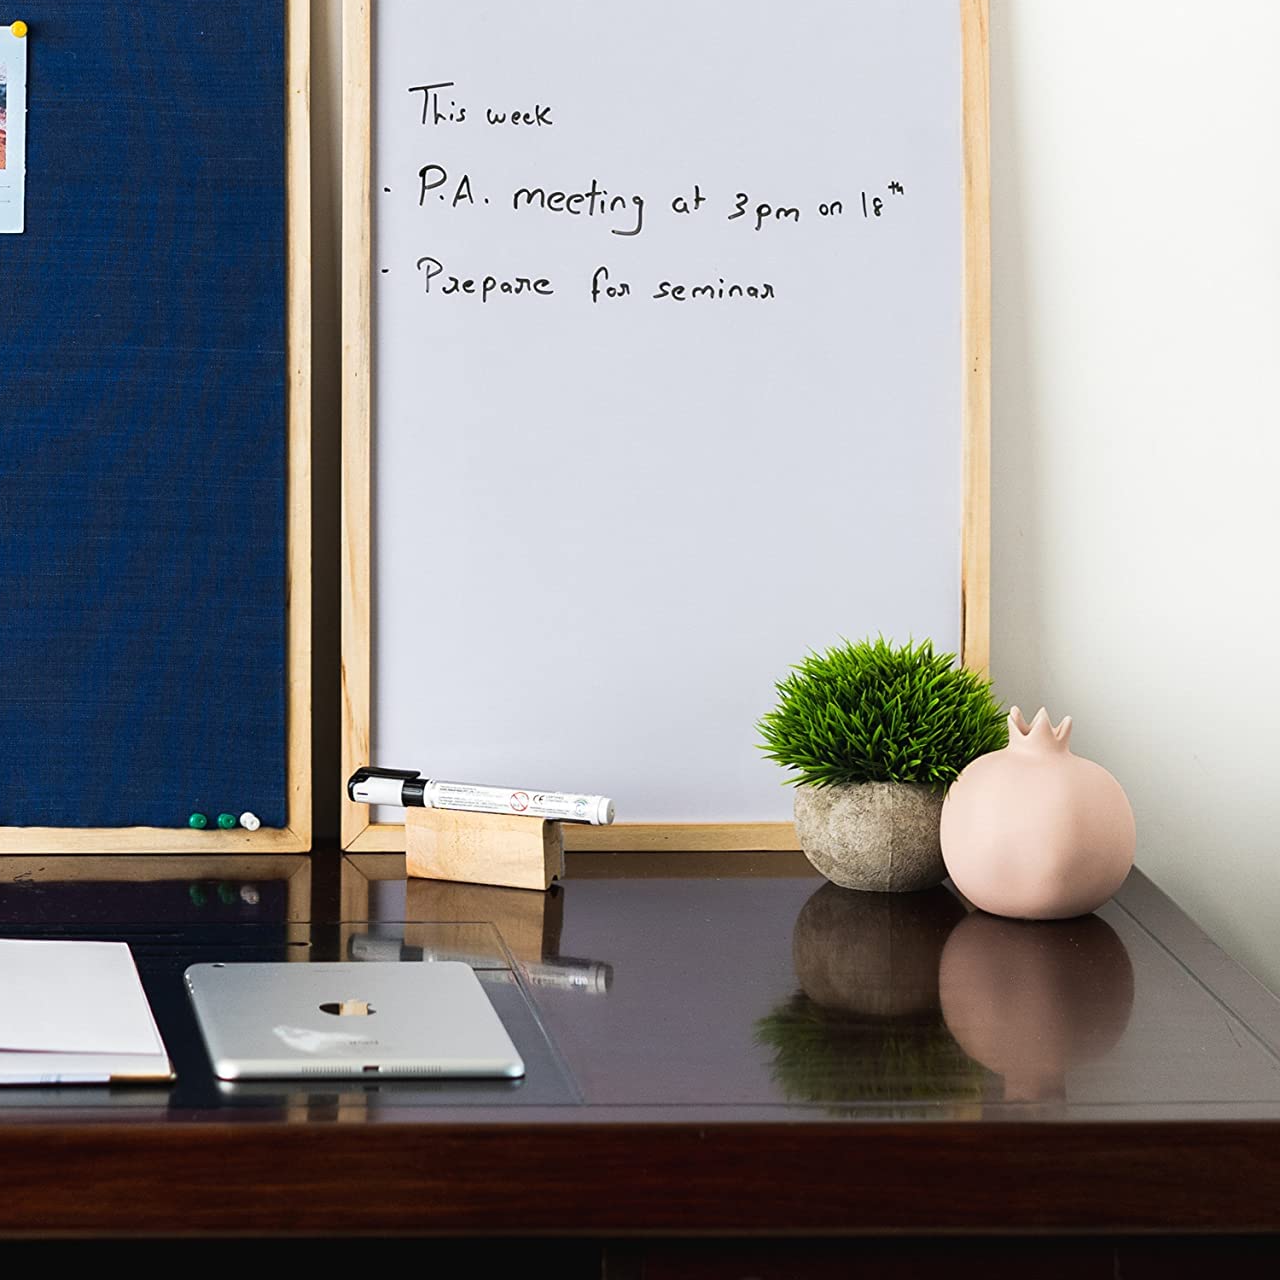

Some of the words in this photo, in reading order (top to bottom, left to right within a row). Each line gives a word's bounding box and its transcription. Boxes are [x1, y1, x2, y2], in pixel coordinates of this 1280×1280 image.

[408, 82, 466, 126] This
[487, 104, 553, 127] week
[418, 164, 489, 208] P.A.
[513, 179, 644, 236] meeting
[671, 184, 707, 215] at
[818, 200, 843, 217] on
[416, 257, 554, 304] Prepare
[591, 266, 631, 303] for
[652, 276, 775, 302] seminar
